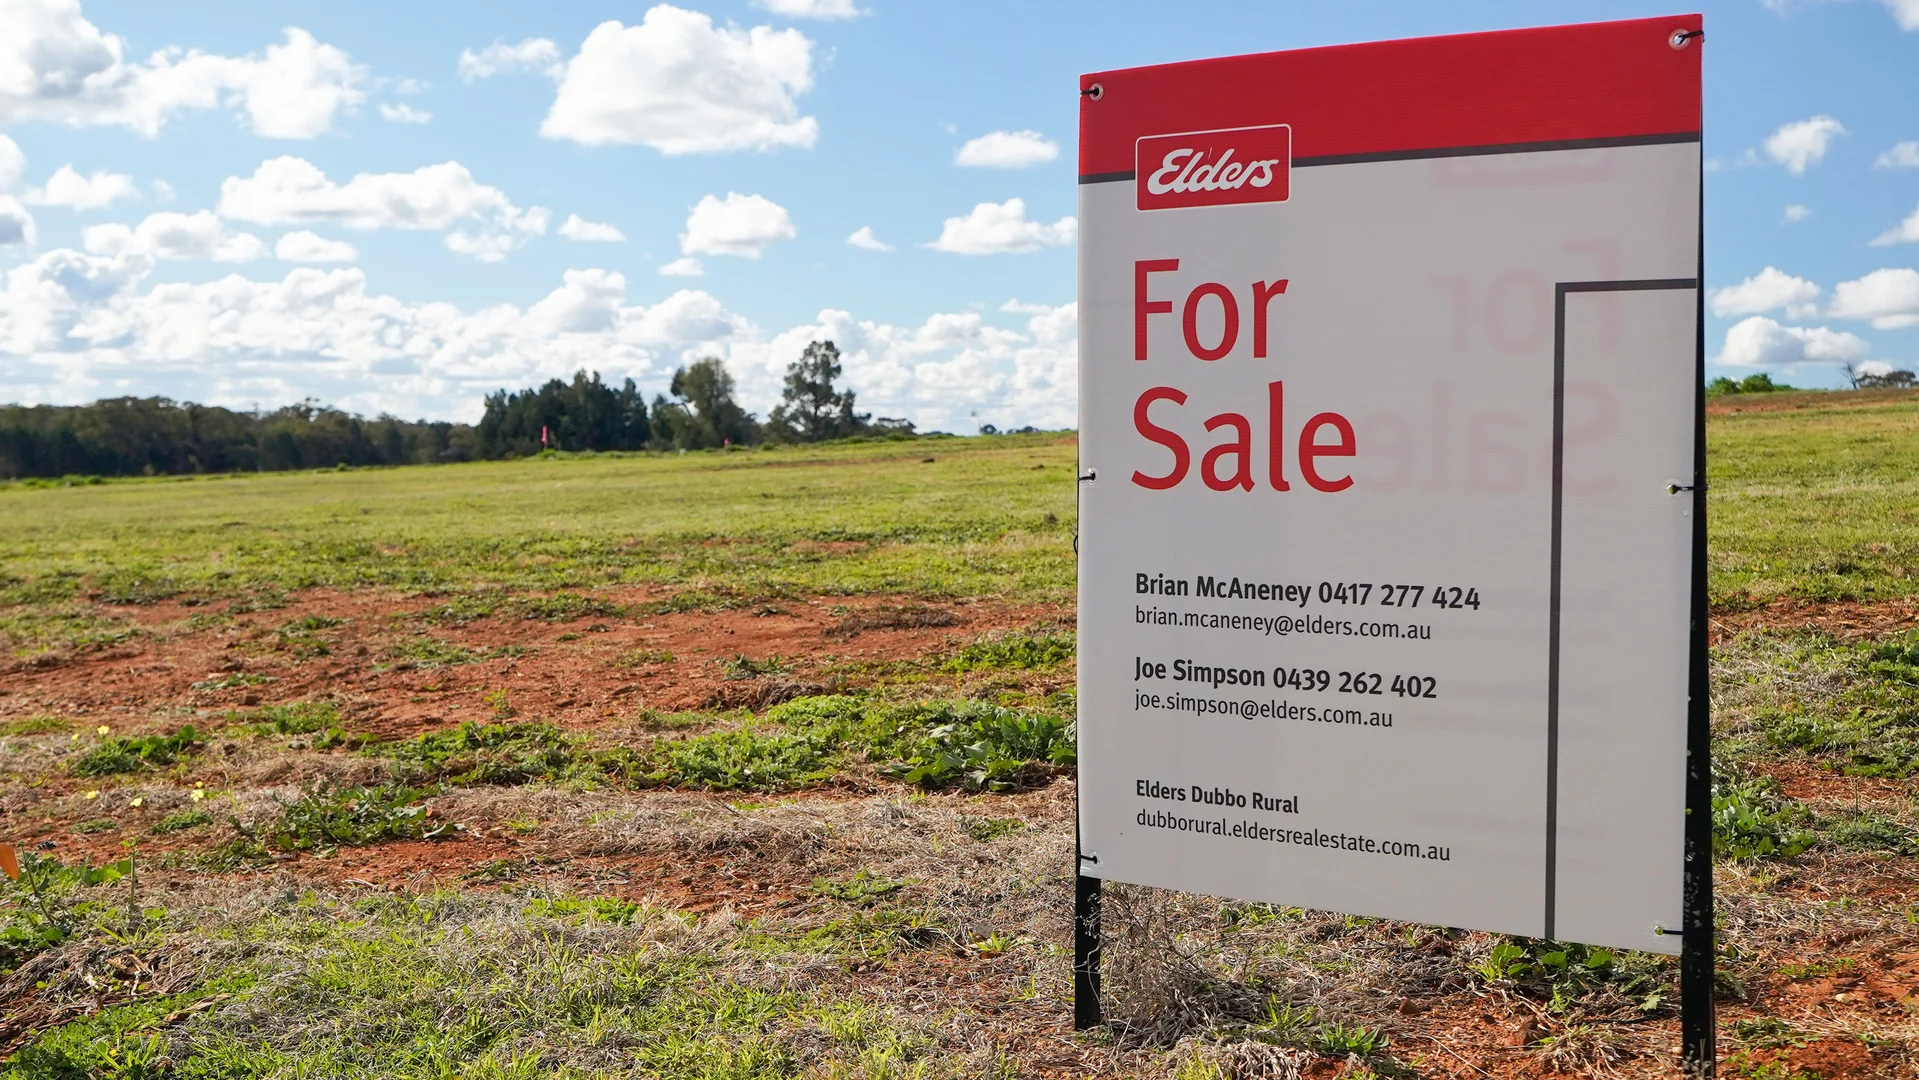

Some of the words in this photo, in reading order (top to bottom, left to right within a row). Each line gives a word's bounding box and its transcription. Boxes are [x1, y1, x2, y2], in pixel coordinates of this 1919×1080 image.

[1147, 147, 1279, 195] Elders
[1135, 258, 1289, 361] For
[1131, 380, 1357, 493] Sale
[1136, 572, 1189, 597] Brian
[1195, 575, 1312, 609] McAneney
[1318, 581, 1373, 606] 0417
[1380, 583, 1425, 608] 277
[1431, 586, 1481, 611] 424
[1135, 604, 1431, 640] brian.mcaneney@elders.com.au
[1134, 656, 1167, 682] Joe
[1172, 658, 1265, 690] Simpson
[1272, 666, 1331, 693] 0439
[1338, 671, 1383, 696] 262
[1390, 674, 1437, 699] 402
[1134, 688, 1393, 728] joe.simpson@elders.com.au
[1136, 779, 1187, 802] Elders
[1191, 785, 1247, 808] Dubbo
[1252, 791, 1300, 814] Rural
[1136, 808, 1451, 862] dubborural.eldersrealestate.com.au
